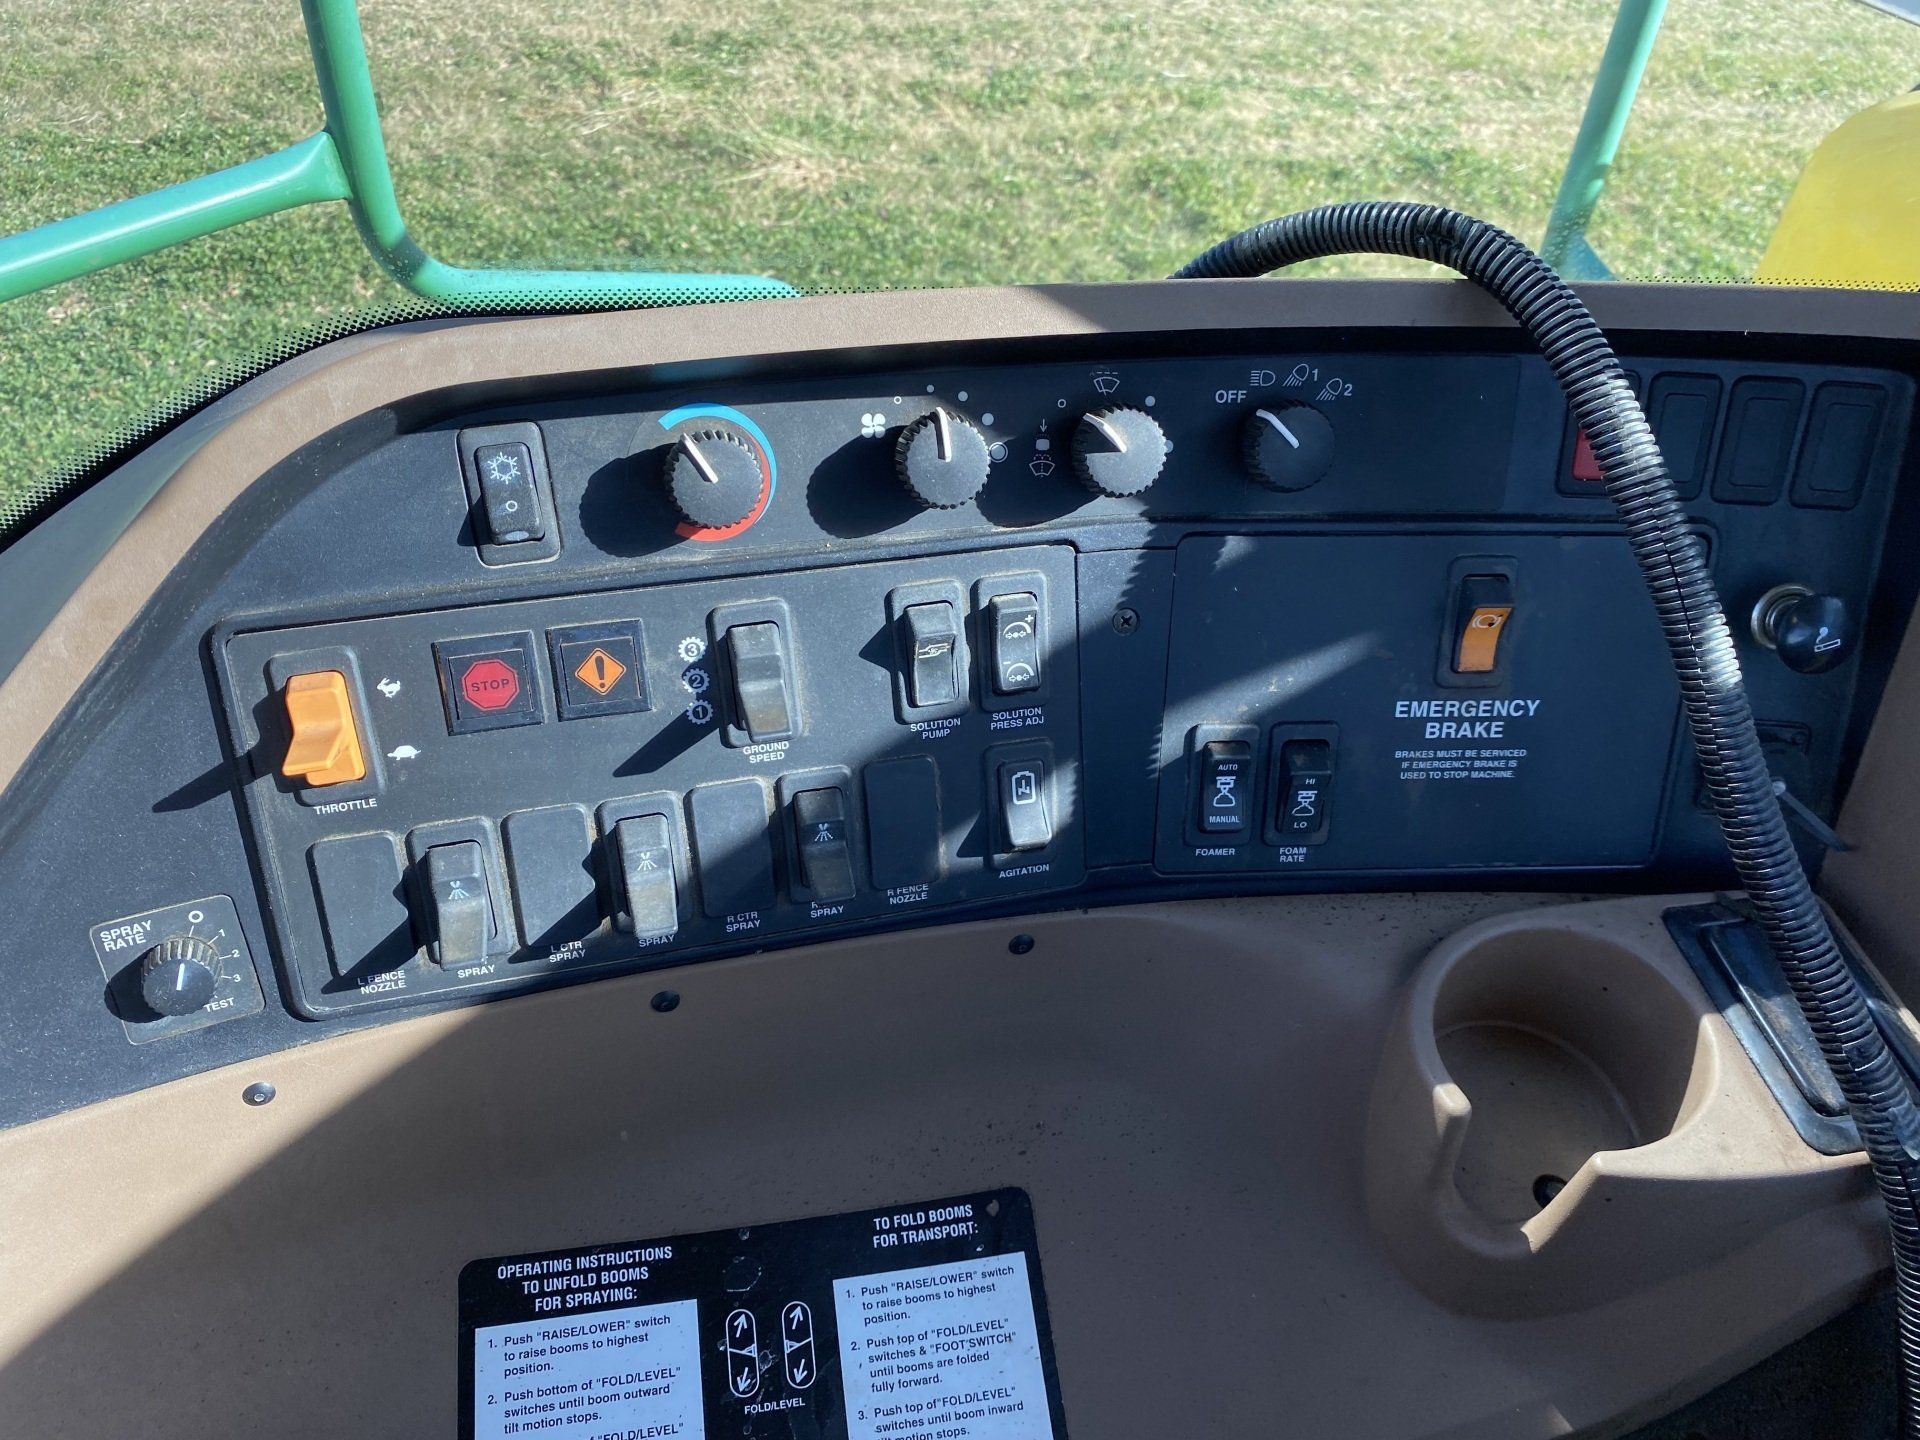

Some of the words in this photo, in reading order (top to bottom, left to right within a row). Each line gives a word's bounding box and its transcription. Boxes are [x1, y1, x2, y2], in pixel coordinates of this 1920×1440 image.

[1215, 390, 1247, 403] OFF
[687, 643, 698, 657] 3
[471, 678, 510, 692] STOP
[691, 674, 702, 688] 2
[992, 707, 1042, 721] SOLUTION
[1395, 699, 1540, 718] EMERGENCY
[910, 718, 961, 732] SOLUTION
[991, 718, 1022, 730] PRESS
[1025, 716, 1044, 726] ADJ
[1425, 721, 1504, 739] BRAKE
[922, 728, 950, 739] PUMP
[743, 741, 790, 755] GROUND
[1395, 750, 1434, 759] BRAKES
[1436, 750, 1462, 758] MUST
[1465, 749, 1477, 757] BE
[1480, 749, 1527, 757] SERVICED
[749, 751, 785, 764] SPEED
[1402, 761, 1410, 769] IF
[1412, 760, 1471, 769] EMERGENCY
[1474, 760, 1506, 768] BRAKE
[1400, 771, 1426, 779] USED
[1428, 771, 1441, 779] TO
[1443, 770, 1468, 778] STOP
[313, 798, 377, 815] THROTTLE
[1209, 815, 1240, 823] MANUAL
[1195, 848, 1235, 856] FOAMER
[1280, 847, 1307, 855] FOAM
[1279, 855, 1305, 863] RATE
[999, 864, 1049, 878] AGITATION
[887, 888, 894, 896] R
[897, 884, 929, 895] FENCE
[890, 892, 928, 905] NOZZLE
[728, 914, 735, 923] R
[738, 912, 758, 922] CTR
[811, 905, 844, 918] SPRAY
[100, 920, 152, 942] SPRAY
[726, 920, 761, 932] SPRAY
[104, 933, 146, 952] RATE
[551, 944, 558, 952] L
[561, 941, 582, 952] CTR
[639, 935, 675, 947] SPRAY
[231, 949, 240, 958] 2
[550, 949, 586, 962] SPRAY
[232, 973, 241, 982] 3
[367, 970, 406, 984] FENCE
[457, 965, 495, 978] SPRAY
[361, 980, 406, 994] NOZZLE
[204, 998, 235, 1013] TEST
[873, 1217, 890, 1231] TO
[894, 1212, 925, 1228] FOLD
[929, 1204, 973, 1223] BOOMS
[873, 1233, 898, 1248] FOR
[901, 1221, 978, 1243] TRANSPORT:
[497, 1258, 572, 1280] OPERATING
[576, 1246, 673, 1270] INSTRUCTIONS
[522, 1280, 539, 1295] TO
[543, 1273, 597, 1292] UNFOLD
[601, 1267, 649, 1285] BOOMS
[846, 1290, 855, 1299] 1.
[861, 1285, 888, 1297] Push
[891, 1271, 978, 1291] "RAISE/LOWER"
[981, 1266, 1014, 1279] switch
[535, 1296, 561, 1312] FOR
[566, 1287, 637, 1308] SPRAYING:
[863, 1301, 873, 1310] to
[876, 1298, 902, 1309] raise
[905, 1292, 941, 1304] booms
[944, 1290, 954, 1299] to
[957, 1283, 996, 1298] highest
[864, 1311, 911, 1327] position.
[488, 1338, 497, 1349] 1.
[504, 1334, 533, 1347] Push
[536, 1319, 631, 1341] "RAISE/LOWER"
[634, 1315, 671, 1329] switch
[850, 1341, 861, 1351] 2.
[866, 1336, 894, 1349] Push
[897, 1333, 915, 1347] top
[917, 1331, 929, 1342] of
[931, 1319, 1009, 1340] "FOLD/LEVEL"
[504, 1350, 515, 1362] to
[518, 1347, 547, 1360] raise
[549, 1341, 589, 1356] booms
[592, 1339, 604, 1350] to
[606, 1332, 649, 1349] highest
[868, 1348, 916, 1364] switches
[919, 1346, 928, 1356] &
[504, 1361, 554, 1379] position.
[870, 1366, 894, 1378] until
[897, 1361, 934, 1374] booms
[937, 1358, 954, 1368] are
[956, 1352, 990, 1365] folded
[487, 1394, 497, 1405] 2.
[504, 1389, 533, 1403] Push
[537, 1383, 578, 1398] bottom
[581, 1380, 594, 1391] of
[596, 1367, 681, 1389] "FOLD/LEVEL"
[871, 1379, 896, 1393] fully
[898, 1373, 943, 1389] forward.
[504, 1403, 556, 1419] switches
[558, 1397, 584, 1411] until
[587, 1391, 620, 1405] boom
[623, 1383, 671, 1400] outward
[744, 1398, 805, 1415] FOLD/LEVEL
[858, 1410, 868, 1421] 3.
[874, 1405, 903, 1418] Push
[905, 1402, 924, 1415] top
[926, 1399, 937, 1410] of
[937, 1387, 1016, 1407] "FOLD/LEVEL"
[504, 1422, 519, 1434] tilt
[522, 1416, 564, 1432] motion
[566, 1411, 602, 1428] stops.
[876, 1419, 925, 1434] switches
[927, 1412, 952, 1426] until
[954, 1408, 985, 1421] boom
[988, 1401, 1024, 1416] inward
[936, 1426, 970, 1440] stops.
